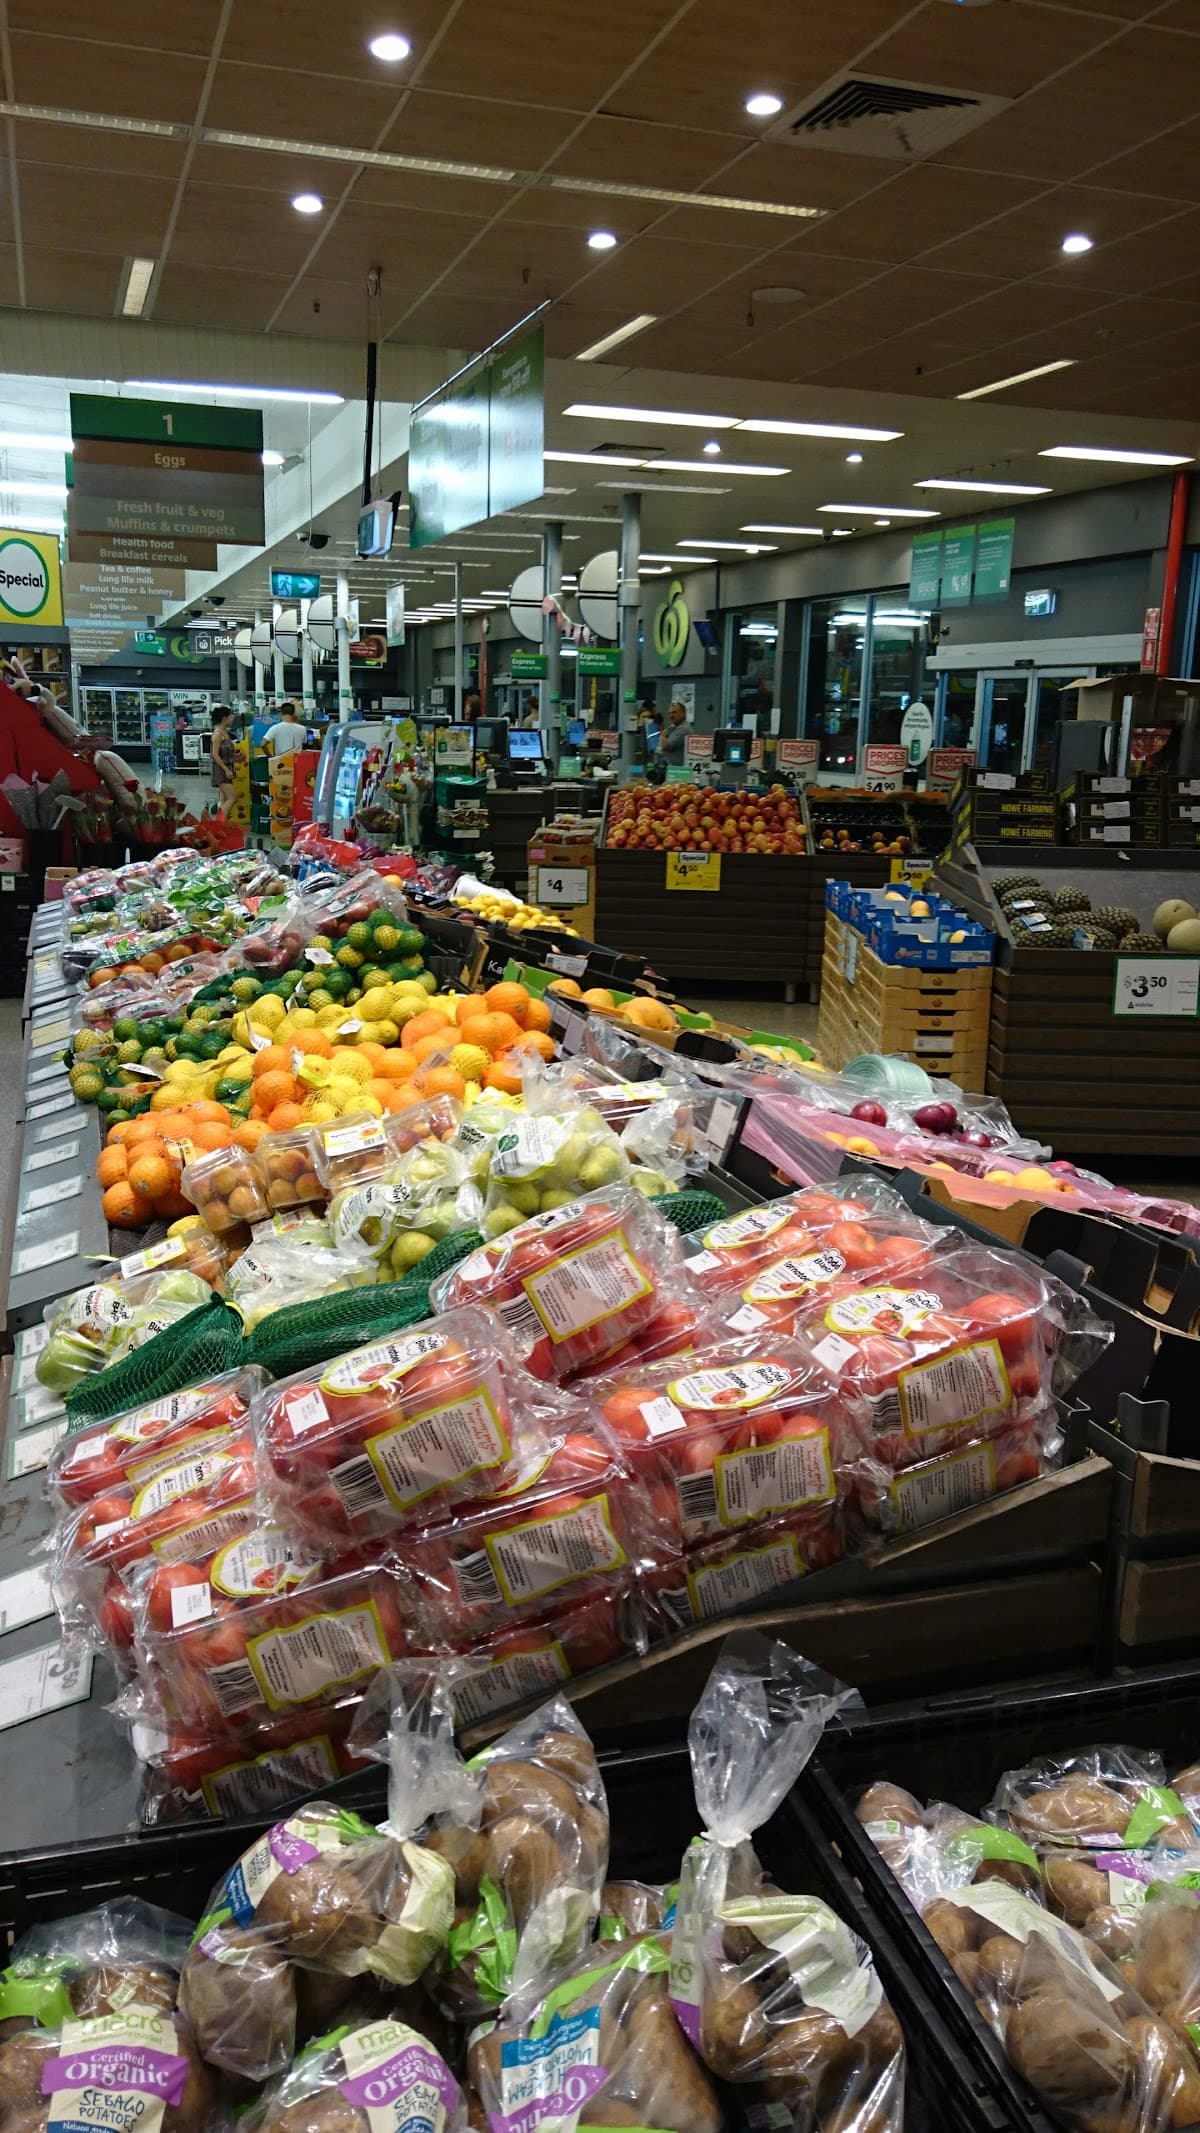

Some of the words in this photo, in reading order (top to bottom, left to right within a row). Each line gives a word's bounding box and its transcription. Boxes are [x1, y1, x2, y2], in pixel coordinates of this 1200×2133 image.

[162, 414, 173, 435] 1
[155, 453, 186, 467] Eggs
[116, 501, 151, 514] Fresh
[155, 502, 184, 516] fruit
[188, 505, 199, 516] &
[201, 508, 225, 520] veg
[107, 517, 157, 531] Muffins
[160, 520, 170, 531] &
[174, 523, 236, 539] crumpets
[113, 537, 147, 547] Health
[150, 539, 174, 549] food
[100, 549, 149, 561] Breakfast
[151, 551, 188, 563] cereals
[101, 565, 115, 573] Tea
[118, 565, 125, 573] &
[126, 565, 152, 574] coffee
[0, 570, 44, 588] Special
[99, 575, 119, 584] Long
[121, 575, 135, 584] life
[136, 576, 154, 585] milk
[80, 584, 109, 593] Peanut
[111, 585, 138, 594] butter
[148, 587, 173, 597] honey
[214, 636, 232, 647] Pick
[512, 658, 536, 666] Express
[580, 653, 606, 661] Express
[870, 751, 905, 760] PRICES
[935, 755, 973, 765] PRICES
[1023, 803, 1054, 814] FARMING
[1022, 828, 1053, 838] FARMING
[91, 2051, 145, 2066] Certified
[65, 2061, 169, 2088] Organic
[80, 2089, 145, 2116] SEBAGO
[79, 2107, 138, 2133] POTATOES
